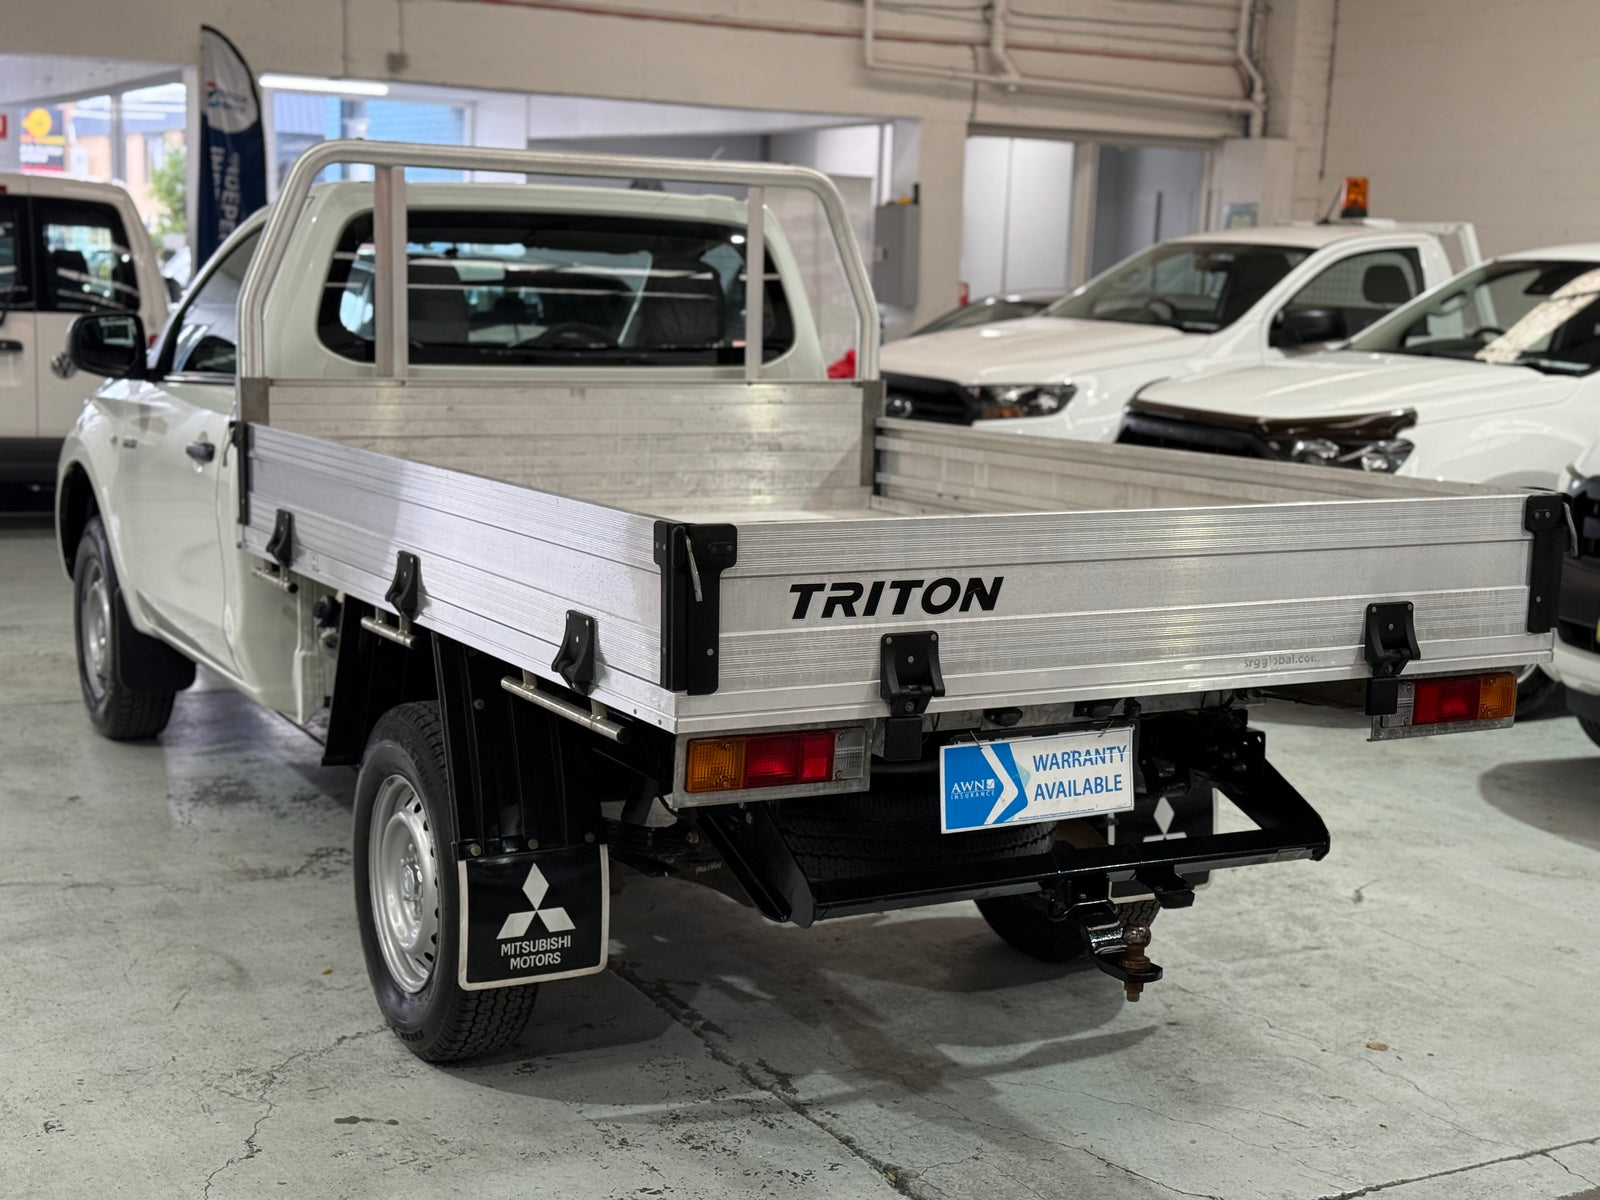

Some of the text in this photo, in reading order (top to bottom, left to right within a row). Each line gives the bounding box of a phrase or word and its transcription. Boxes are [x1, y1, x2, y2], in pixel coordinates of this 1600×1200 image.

[789, 576, 1005, 620] TRITON
[1032, 745, 1127, 772] WARRANTY
[950, 788, 995, 800] INSURANCE
[951, 779, 985, 794] AWN
[1034, 774, 1122, 802] AVAILABLE
[501, 935, 571, 957] MITSUBISHI
[510, 952, 561, 970] MOTORS
